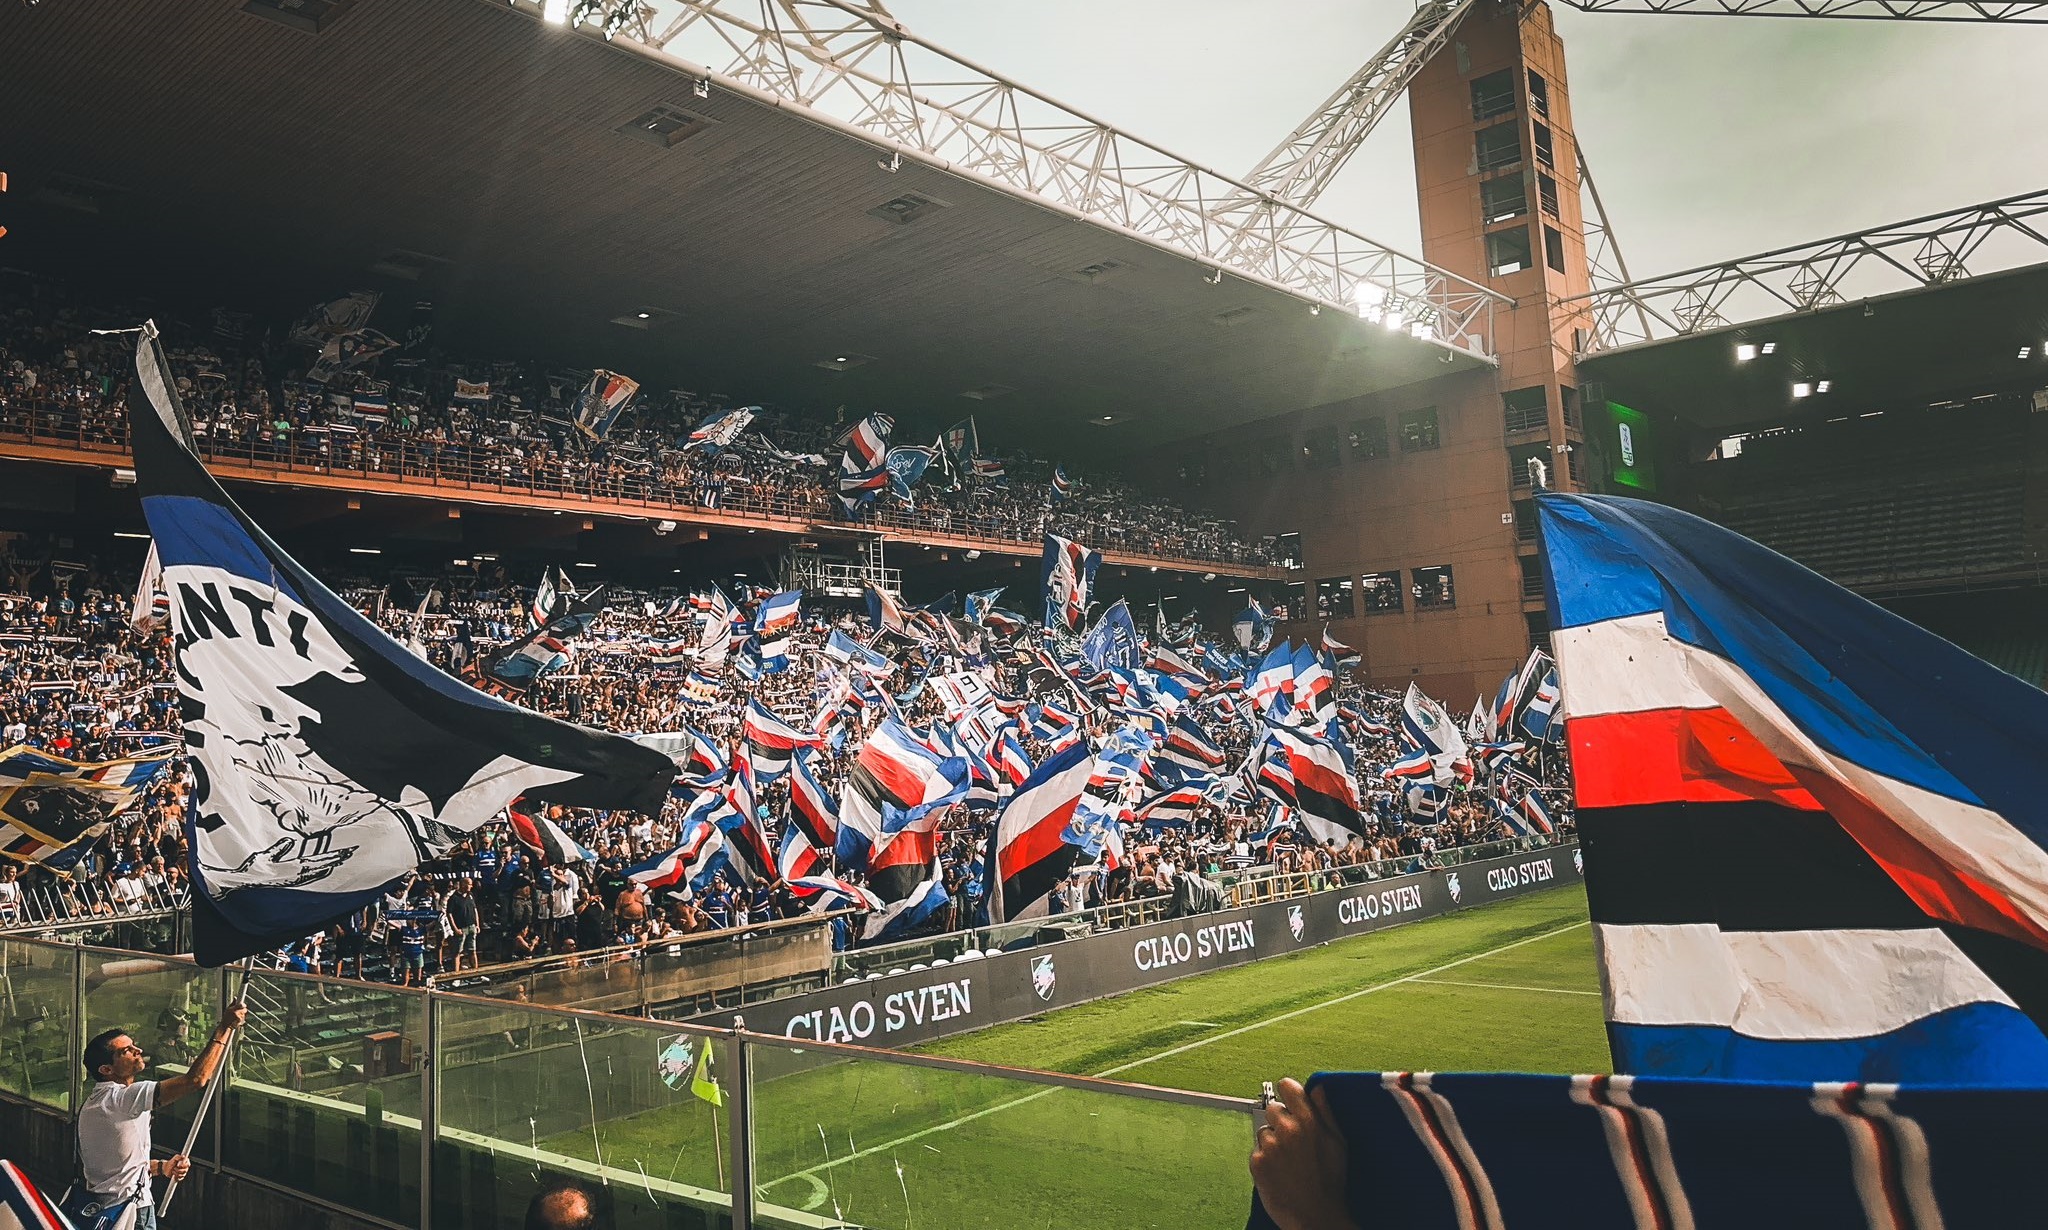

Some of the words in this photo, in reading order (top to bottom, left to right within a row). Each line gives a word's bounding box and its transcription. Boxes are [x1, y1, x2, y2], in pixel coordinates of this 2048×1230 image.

[1487, 865, 1520, 892] CIAO
[1519, 858, 1555, 886] SVEN
[1338, 894, 1380, 925] CIAO
[1382, 884, 1422, 916] SVEN
[1135, 932, 1192, 971] CIAO
[1196, 920, 1256, 959] SVEN
[785, 1000, 876, 1053] CIAO
[884, 978, 971, 1033] SVEN
